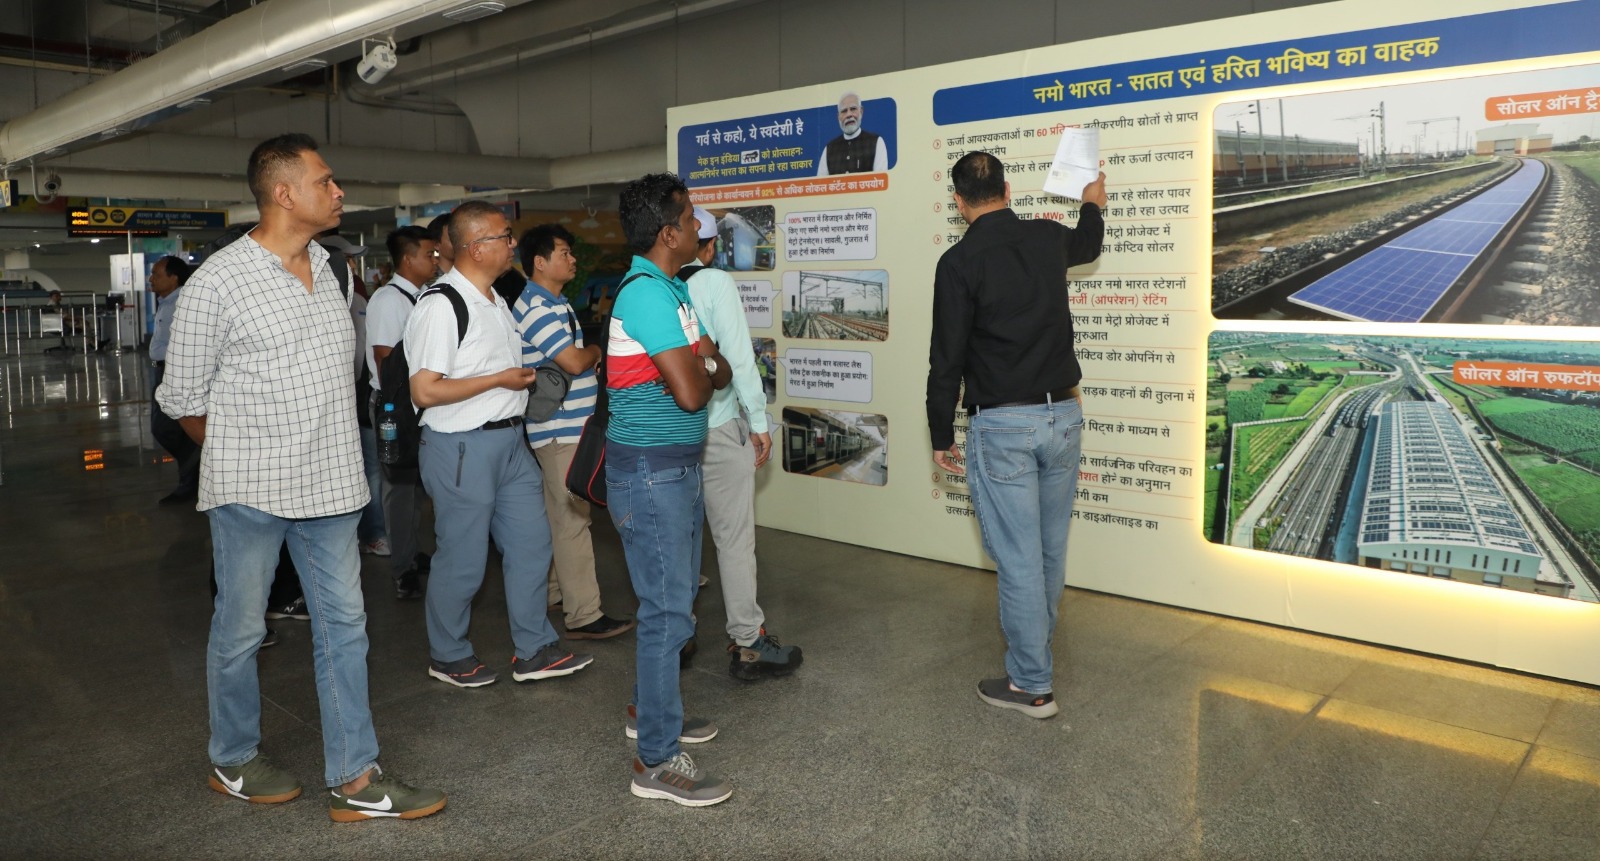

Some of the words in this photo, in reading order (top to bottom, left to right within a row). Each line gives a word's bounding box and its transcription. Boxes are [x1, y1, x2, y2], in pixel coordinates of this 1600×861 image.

[1033, 80, 1064, 103] नमो
[1068, 78, 1112, 98] भारत
[1128, 70, 1173, 92] सतत
[1179, 60, 1206, 88] एवं
[1212, 56, 1261, 84] हरित
[1266, 48, 1330, 74] भविष्य
[1336, 46, 1367, 66] का
[1374, 36, 1440, 62] वाहक
[1496, 98, 1542, 115] सोलर
[1546, 94, 1582, 110] ऑन
[1584, 90, 1600, 110] ट्रै
[696, 129, 710, 146] गर्व
[712, 128, 721, 144] से
[724, 126, 746, 143] कहो,
[749, 124, 758, 140] ये
[760, 118, 793, 138] स्वदेशी
[796, 117, 804, 135] है
[947, 134, 964, 146] ऊर्जा
[967, 128, 1020, 144] आवश्यकताओं
[1024, 129, 1034, 138] का
[1037, 128, 1047, 137] 60
[1164, 112, 1173, 124] से
[1176, 112, 1198, 122] प्राप्त
[710, 156, 719, 166] इन
[761, 150, 770, 159] को
[1028, 161, 1035, 172] से
[1108, 153, 1125, 165] सौर
[1129, 150, 1151, 164] ऊर्जा
[1155, 150, 1193, 162] उत्पादन
[721, 166, 736, 176] भारत
[738, 166, 747, 175] का
[749, 164, 766, 174] सपना
[768, 161, 775, 172] हो
[777, 162, 788, 171] रहा
[790, 159, 813, 170] साकार
[848, 181, 858, 190] का
[860, 177, 884, 189] उपयोग
[1014, 195, 1033, 206] आदि
[1037, 196, 1047, 206] पर
[1121, 188, 1133, 201] रहे
[1137, 188, 1164, 200] सोलर
[1167, 188, 1191, 198] पावर
[1043, 212, 1064, 221] MWp
[1112, 208, 1123, 217] का
[1127, 205, 1136, 217] हो
[1140, 207, 1155, 216] रहा
[1159, 205, 1189, 215] उत्पाद
[1106, 225, 1123, 239] मेट्रो
[1126, 224, 1160, 236] प्रोजेक्ट
[1146, 240, 1174, 251] सोलर
[1074, 280, 1102, 293] गुलधर
[1105, 277, 1122, 289] नमो
[1125, 280, 1149, 289] भारत
[1152, 277, 1186, 289] स्टेशनों
[1091, 292, 1139, 308] (ऑपरेशन)
[1143, 292, 1167, 305] रेटिंग
[1092, 316, 1102, 325] या
[1105, 313, 1122, 327] मेट्रो
[1125, 313, 1158, 326] प्रोजेक्ट
[1161, 313, 1170, 326] में
[1106, 349, 1122, 361] डोर
[1125, 350, 1162, 363] ओपनिंग
[1166, 351, 1175, 364] से
[1458, 364, 1502, 381] सोलर
[1506, 368, 1539, 383] ऑन
[1082, 386, 1108, 398] सड़क
[1111, 386, 1136, 398] वाहनों
[1140, 387, 1152, 399] की
[1155, 390, 1184, 404] तुलना
[1187, 389, 1195, 402] में
[1089, 419, 1114, 434] पिट्स
[1116, 422, 1125, 433] के
[1128, 425, 1158, 436] माध्यम
[1161, 425, 1170, 437] से
[1080, 454, 1087, 465] से
[1090, 456, 1135, 470] सार्वजनिक
[1138, 460, 1176, 475] परिवहन
[1179, 466, 1193, 477] का
[1120, 476, 1132, 486] का
[1135, 479, 1171, 493] अनुमान
[1092, 493, 1108, 503] कम
[1145, 521, 1158, 530] का
